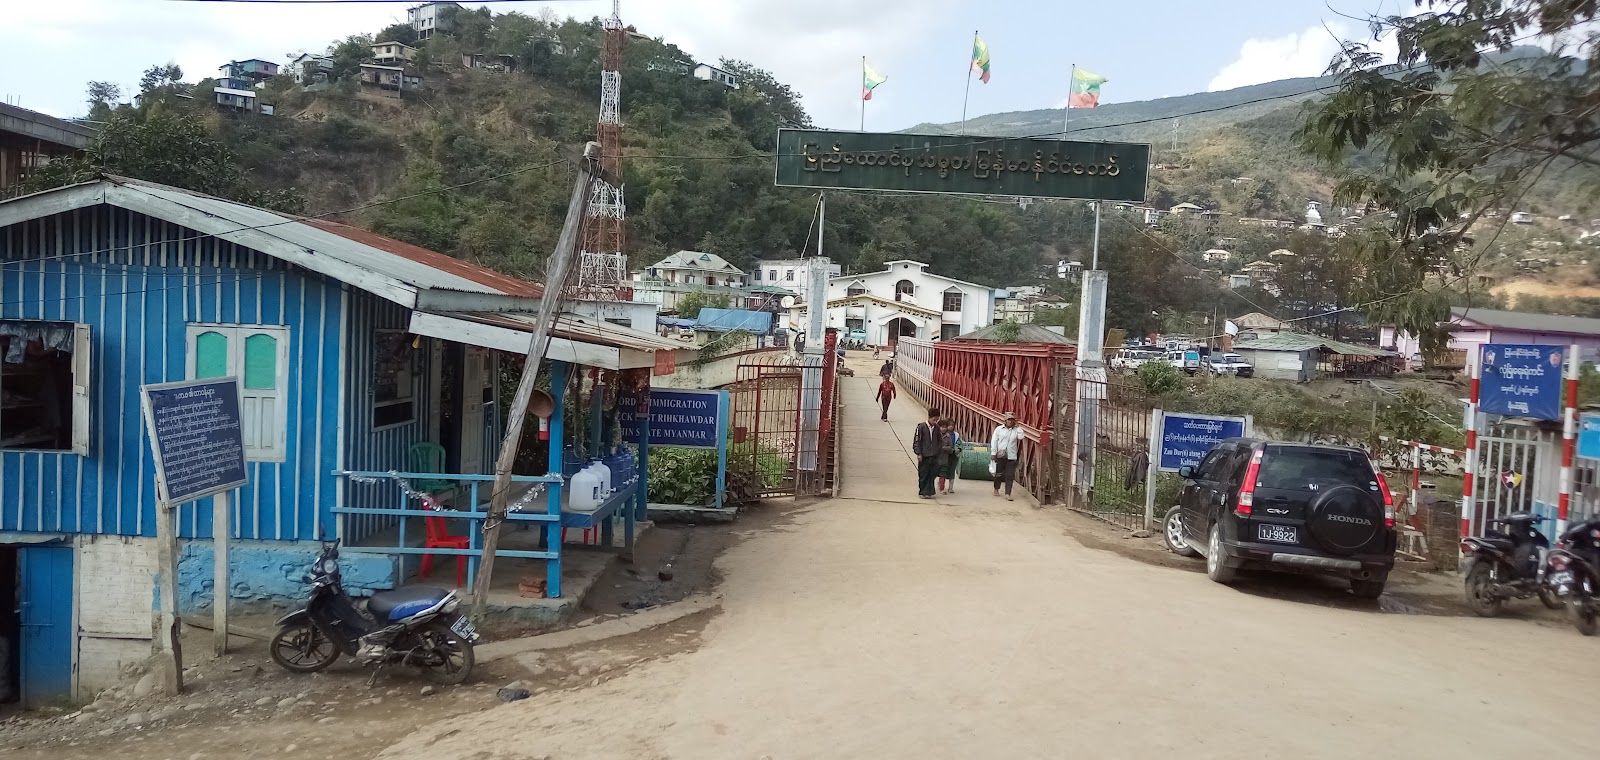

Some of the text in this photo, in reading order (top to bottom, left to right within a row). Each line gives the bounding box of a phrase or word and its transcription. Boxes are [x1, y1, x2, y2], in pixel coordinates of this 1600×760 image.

[649, 398, 708, 409] IMMIGRATION
[657, 413, 715, 425] RIHKHAWDAR
[663, 429, 706, 439] MYANMAR
[1327, 513, 1373, 526] HONDA
[1262, 529, 1295, 541] 1J-9922
